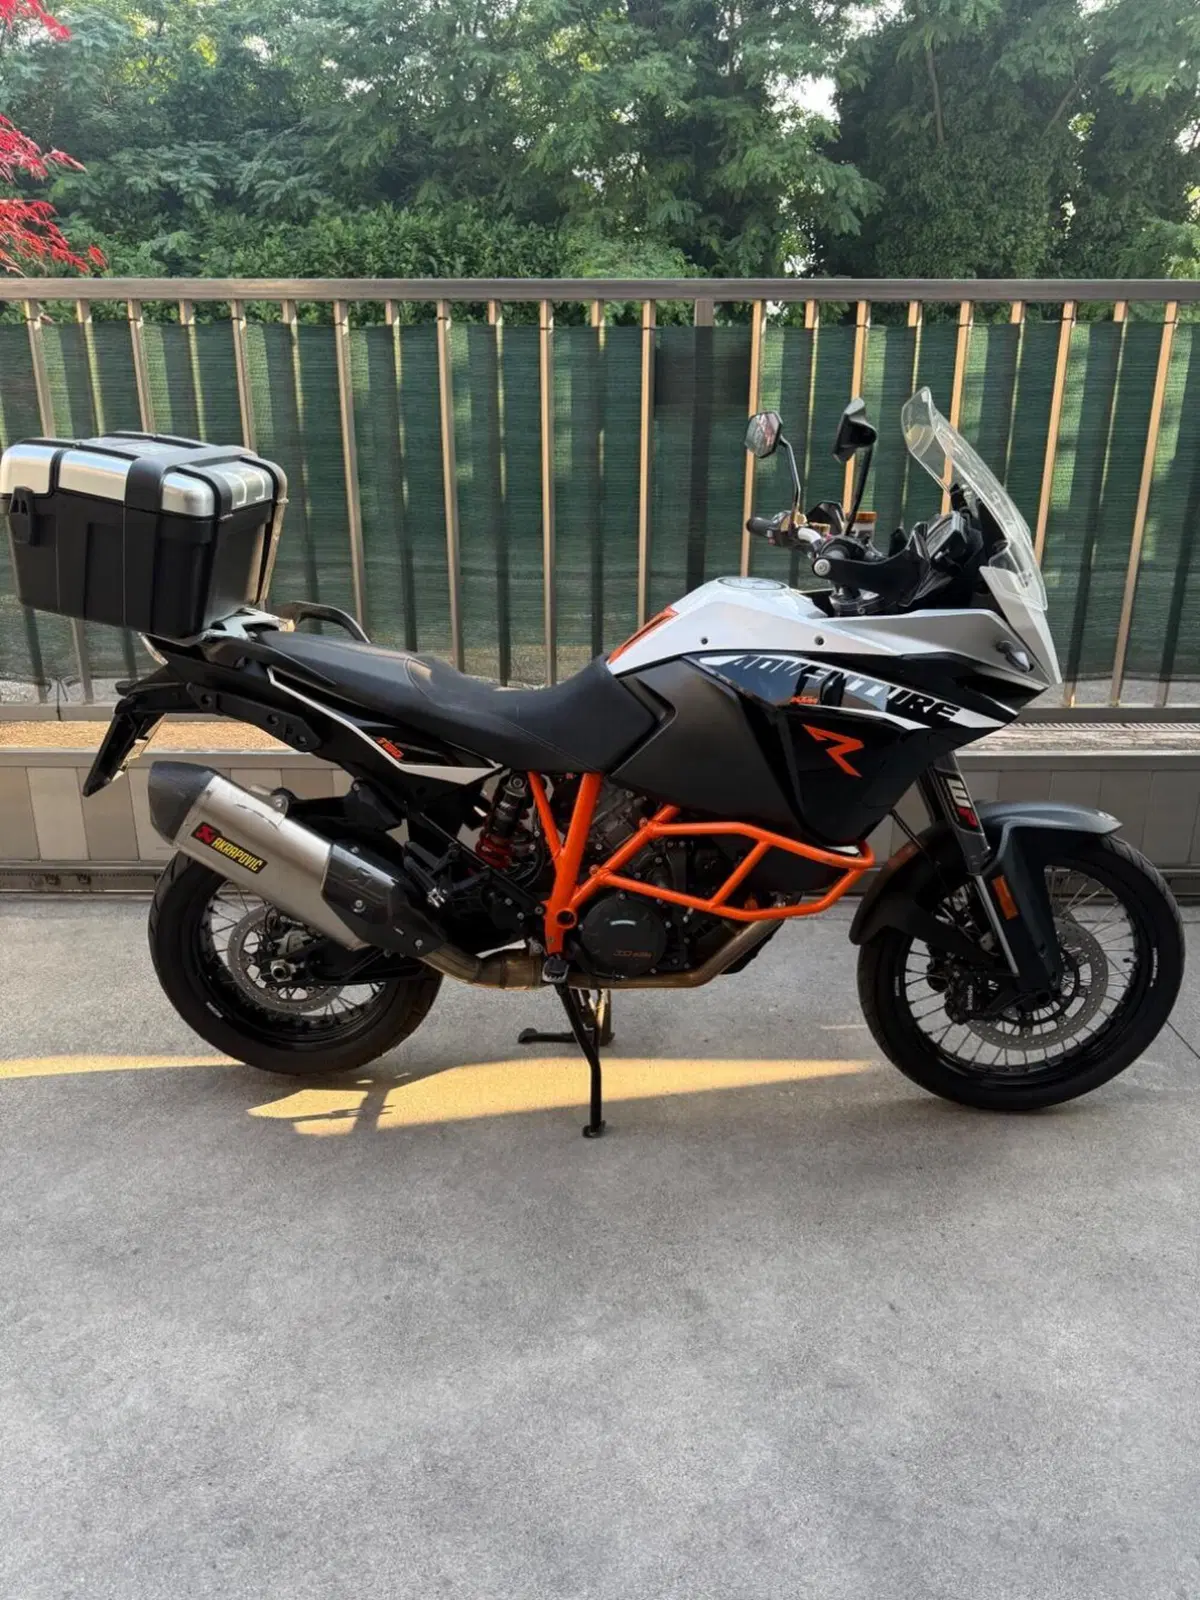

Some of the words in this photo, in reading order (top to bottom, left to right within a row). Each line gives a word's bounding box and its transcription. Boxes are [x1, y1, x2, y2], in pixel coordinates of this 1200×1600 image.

[728, 655, 961, 720] ADVENTURE
[802, 723, 864, 778] R
[945, 778, 978, 828] WP
